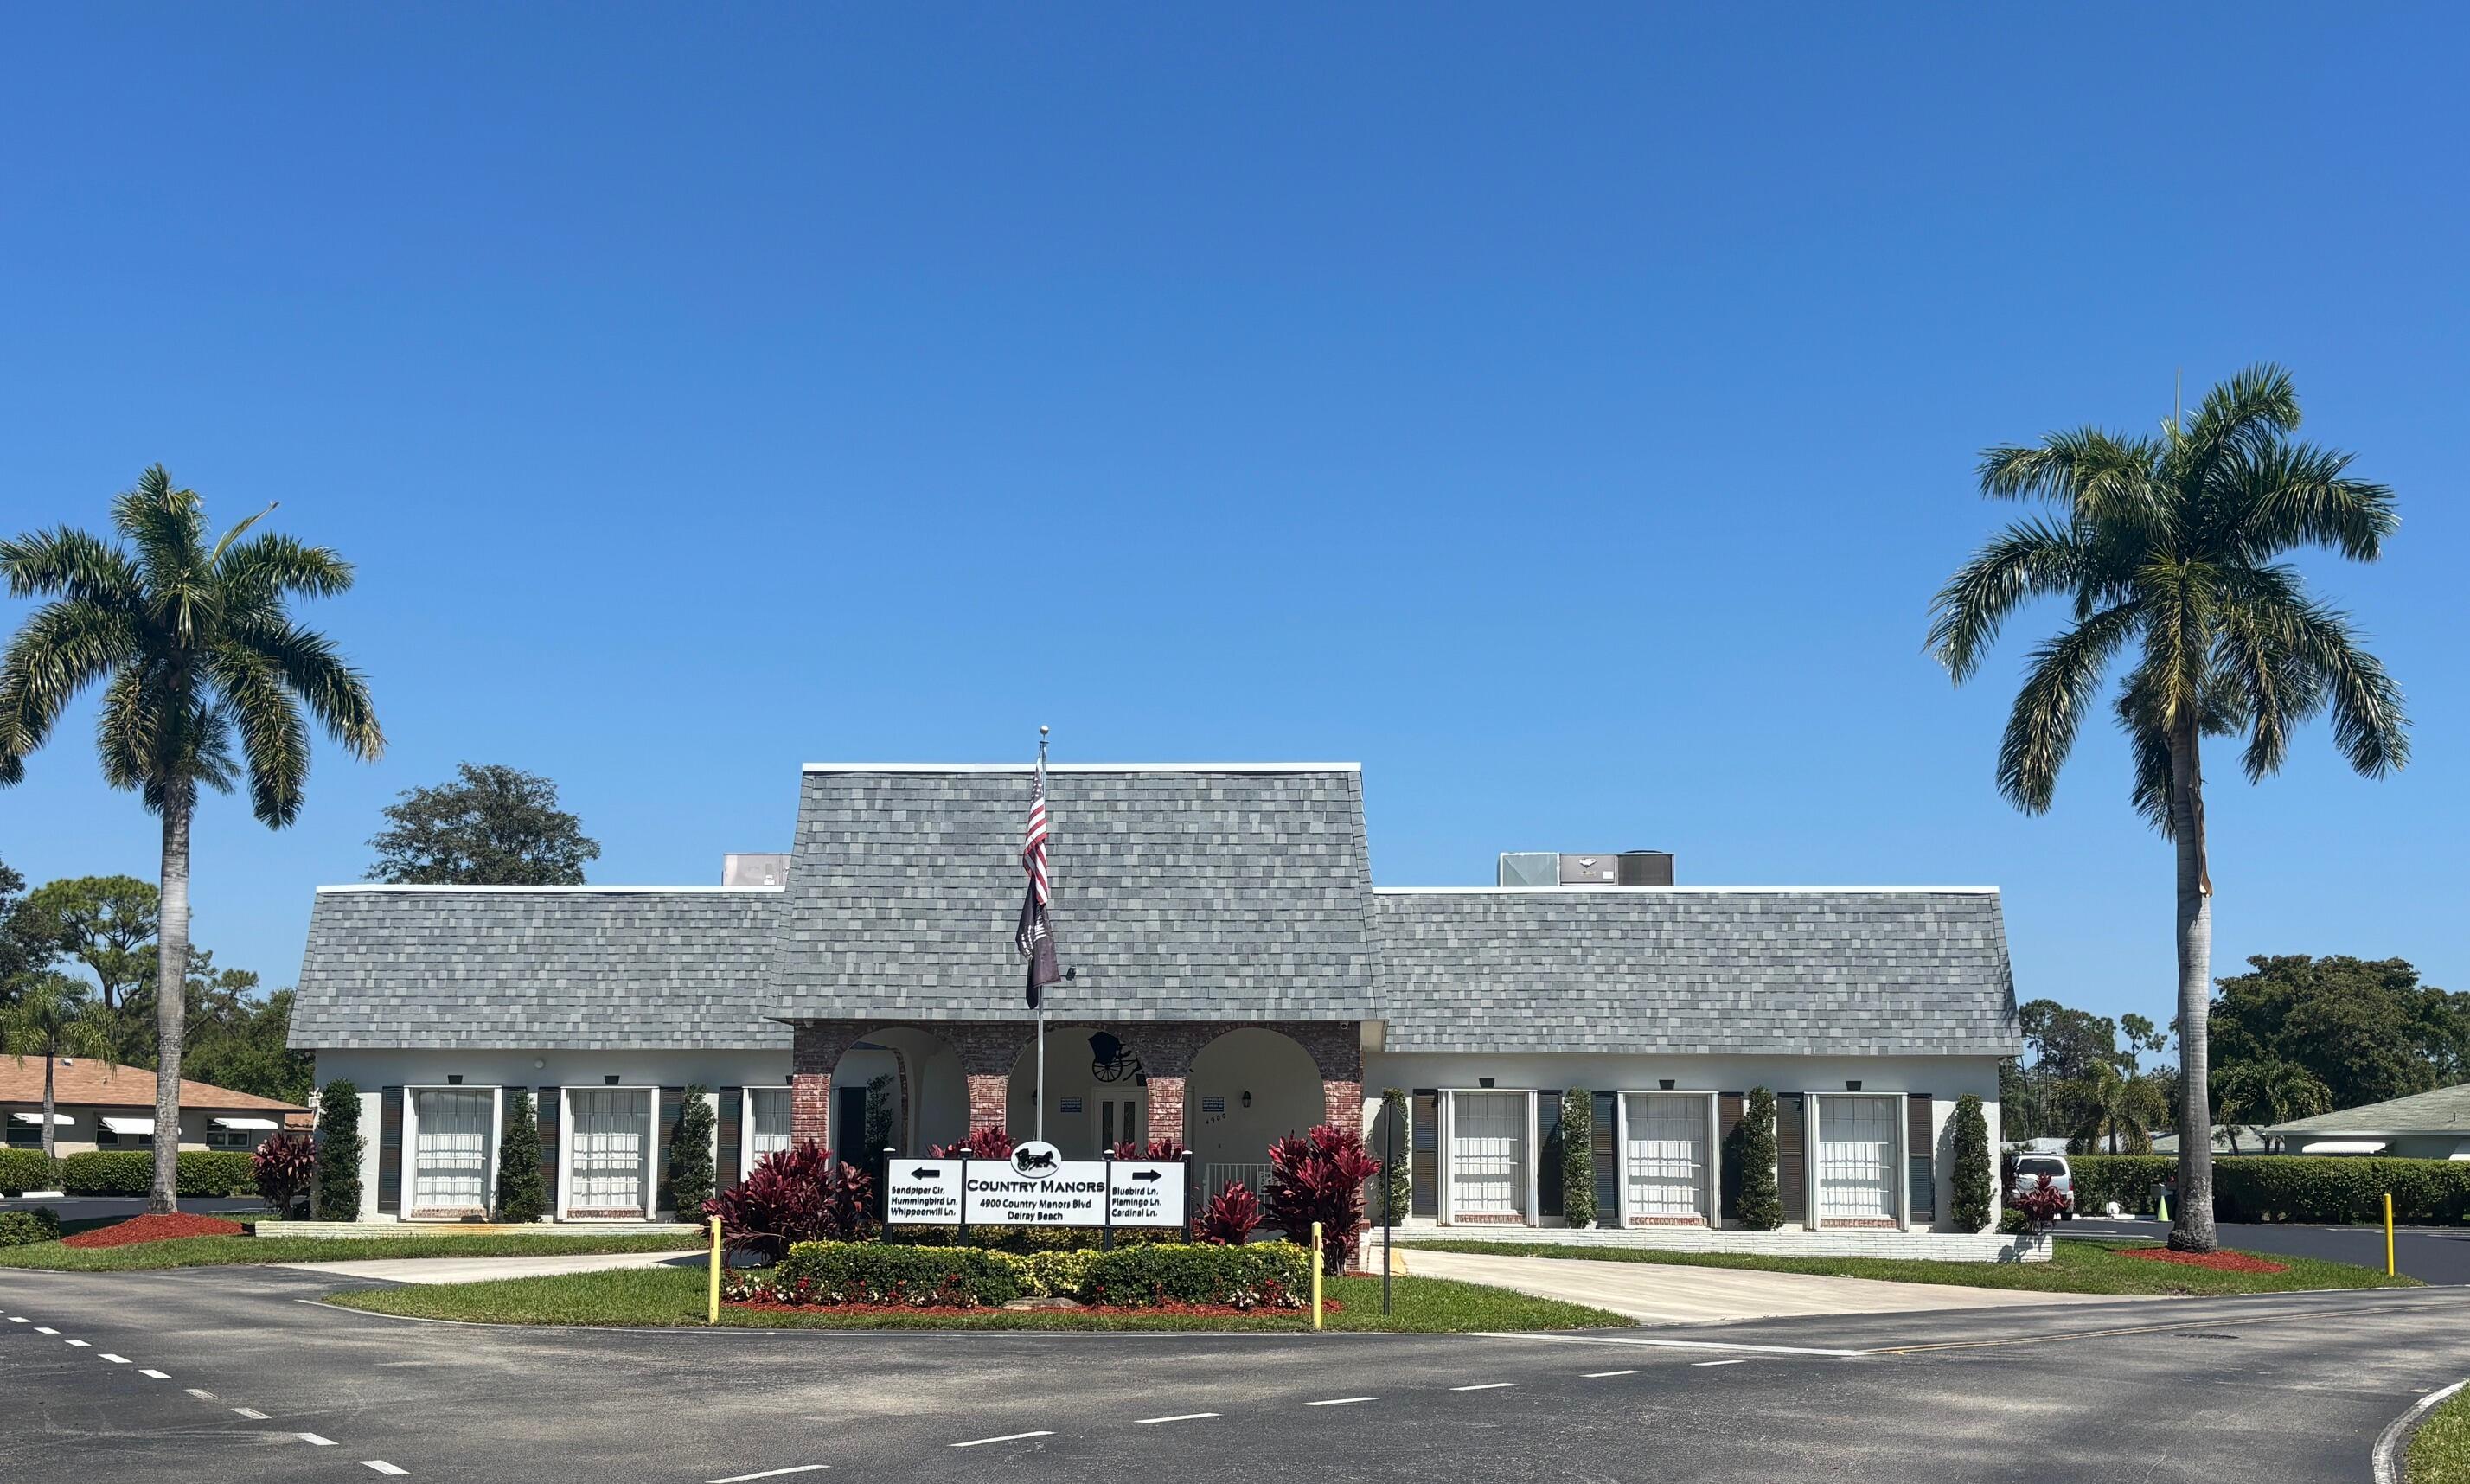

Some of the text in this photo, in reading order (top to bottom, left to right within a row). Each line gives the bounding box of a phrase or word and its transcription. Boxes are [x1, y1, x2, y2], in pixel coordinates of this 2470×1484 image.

[892, 1186, 945, 1196] Sandpiper Cir.
[1112, 1187, 1159, 1196] Bluebird Ln.
[891, 1197, 958, 1207] Hummingbird Ln.
[980, 1199, 1091, 1210] 4900 Country Manors Blvd
[1112, 1198, 1162, 1208] Flamingo Ln.
[891, 1207, 957, 1218] Whippoorwill Ln.
[1008, 1211, 1064, 1222] Delray Beach
[1111, 1208, 1158, 1218] Cardinal Ln.
